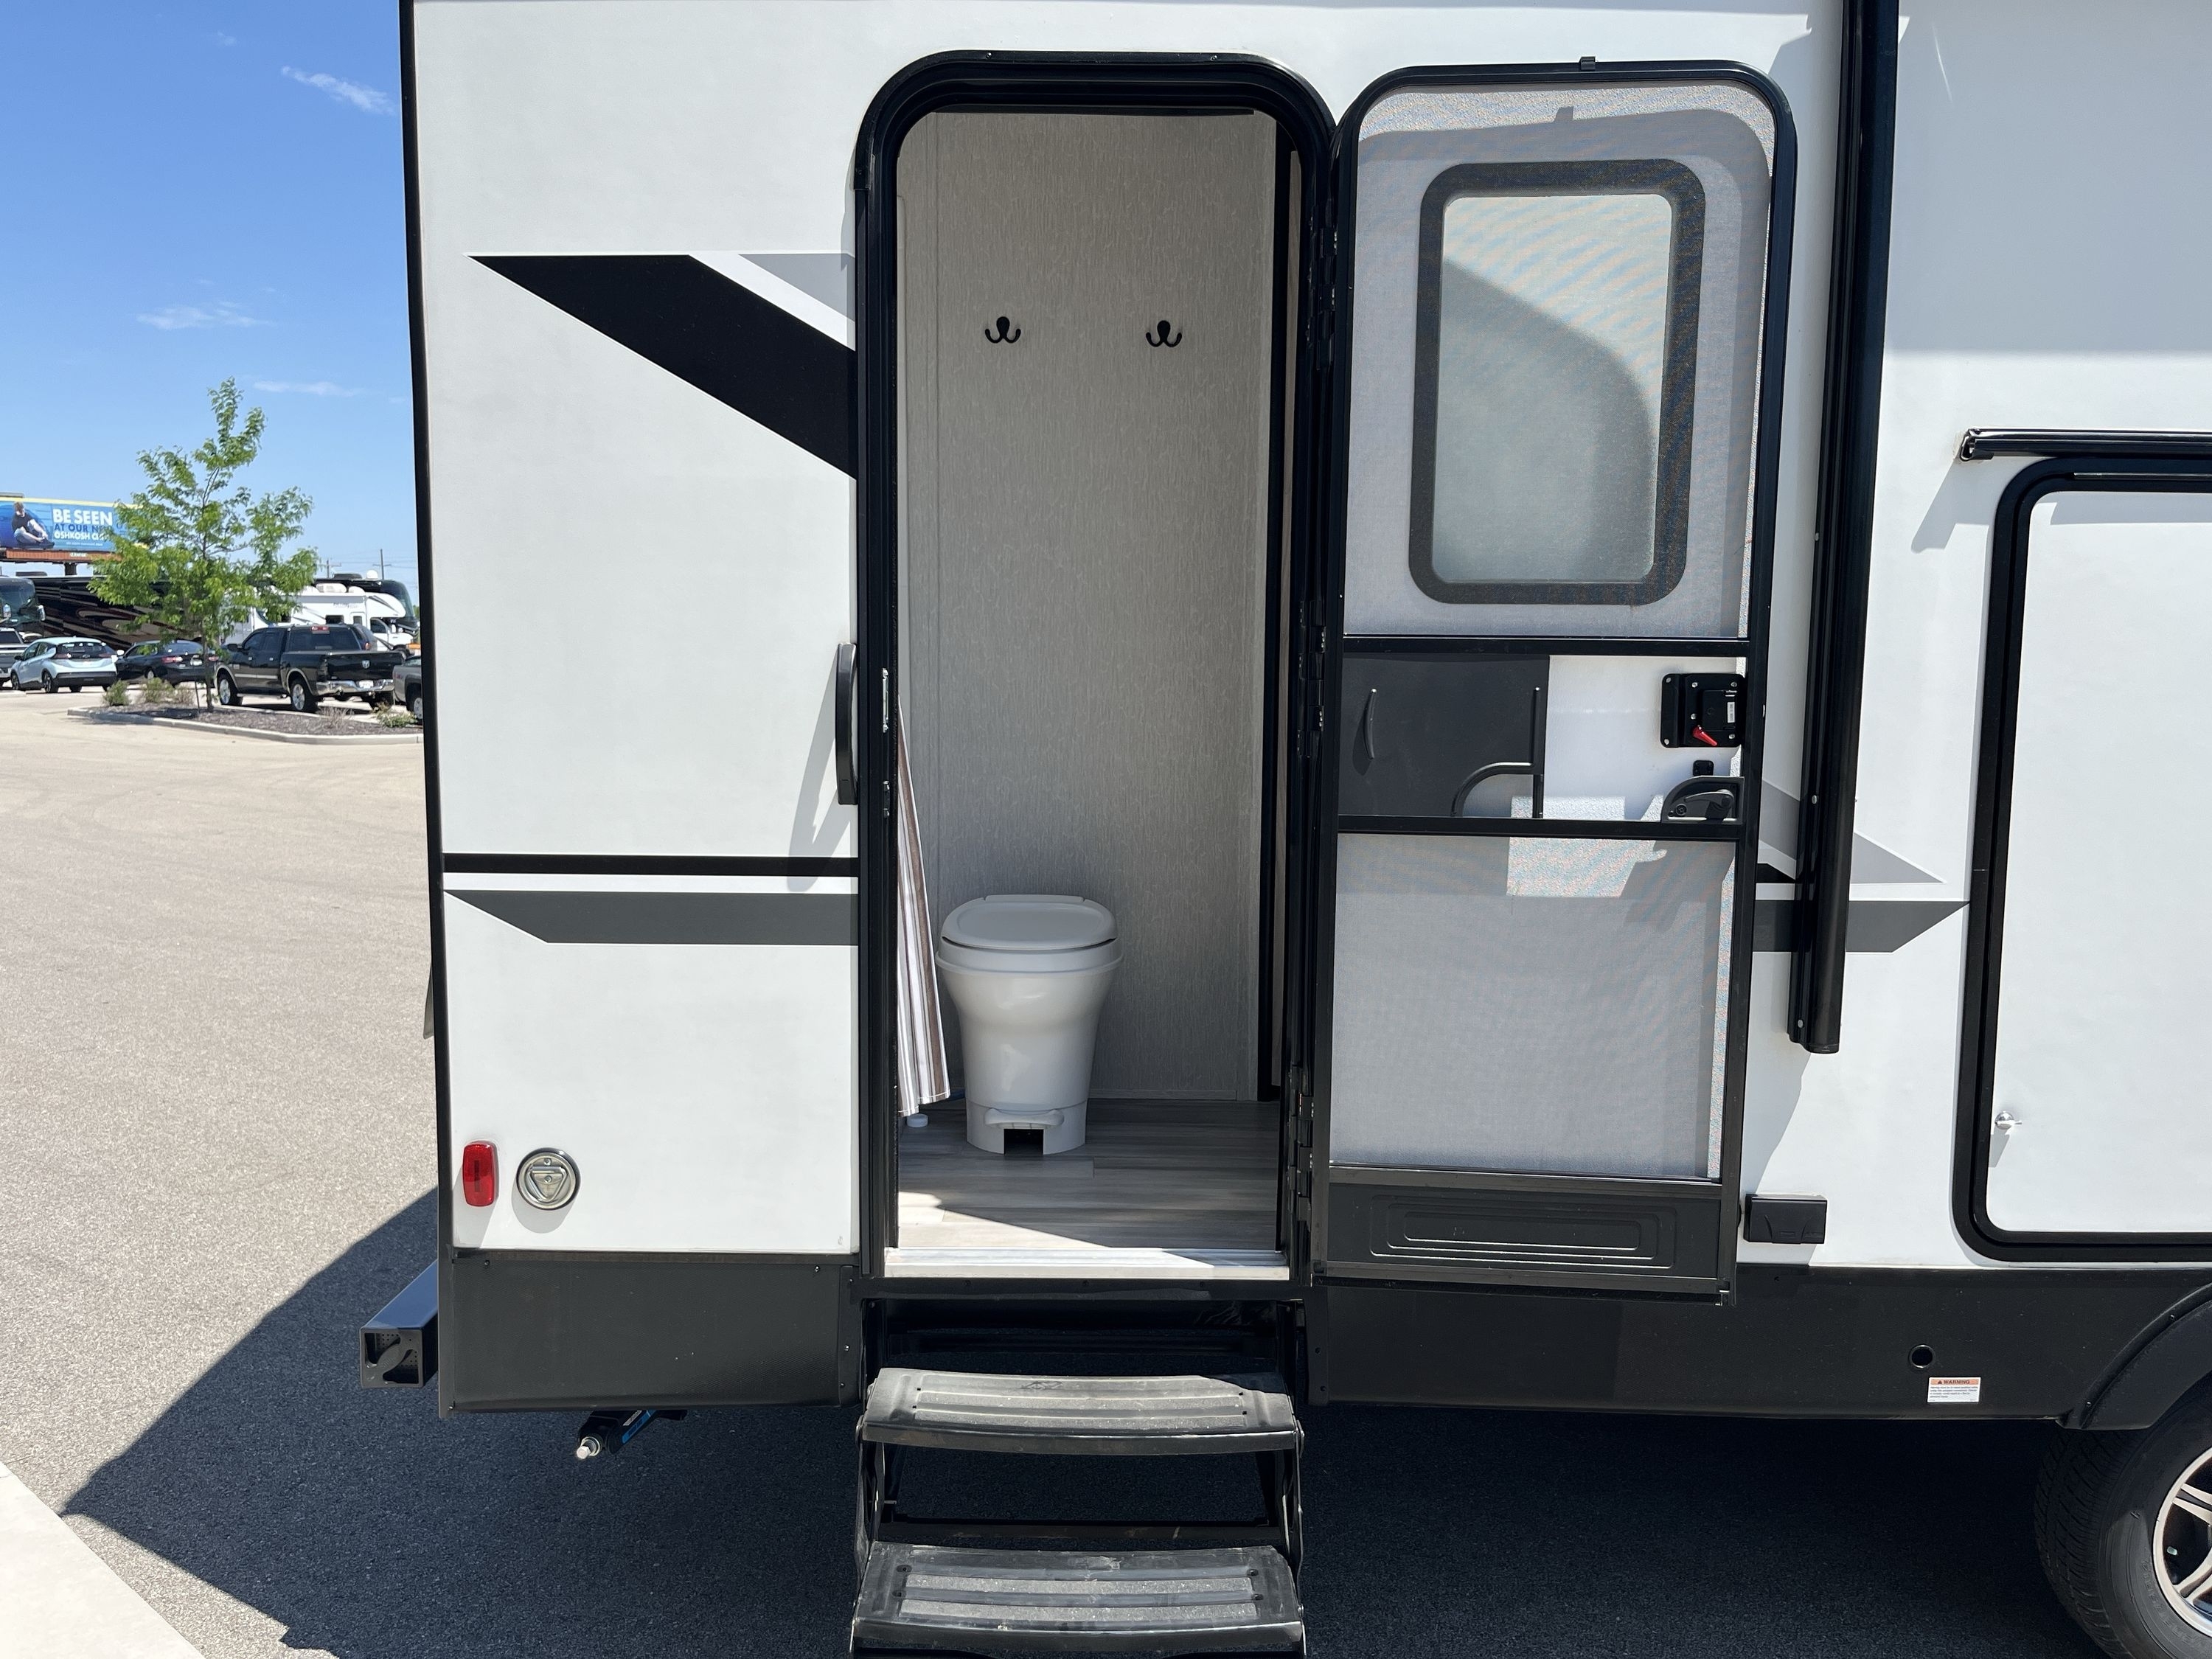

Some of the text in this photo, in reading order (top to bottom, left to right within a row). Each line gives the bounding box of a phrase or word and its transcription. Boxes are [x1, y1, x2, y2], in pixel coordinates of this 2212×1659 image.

[52, 509, 113, 526] BE SEEN
[68, 524, 88, 532] OUR
[54, 530, 91, 540] OSHKOSH
